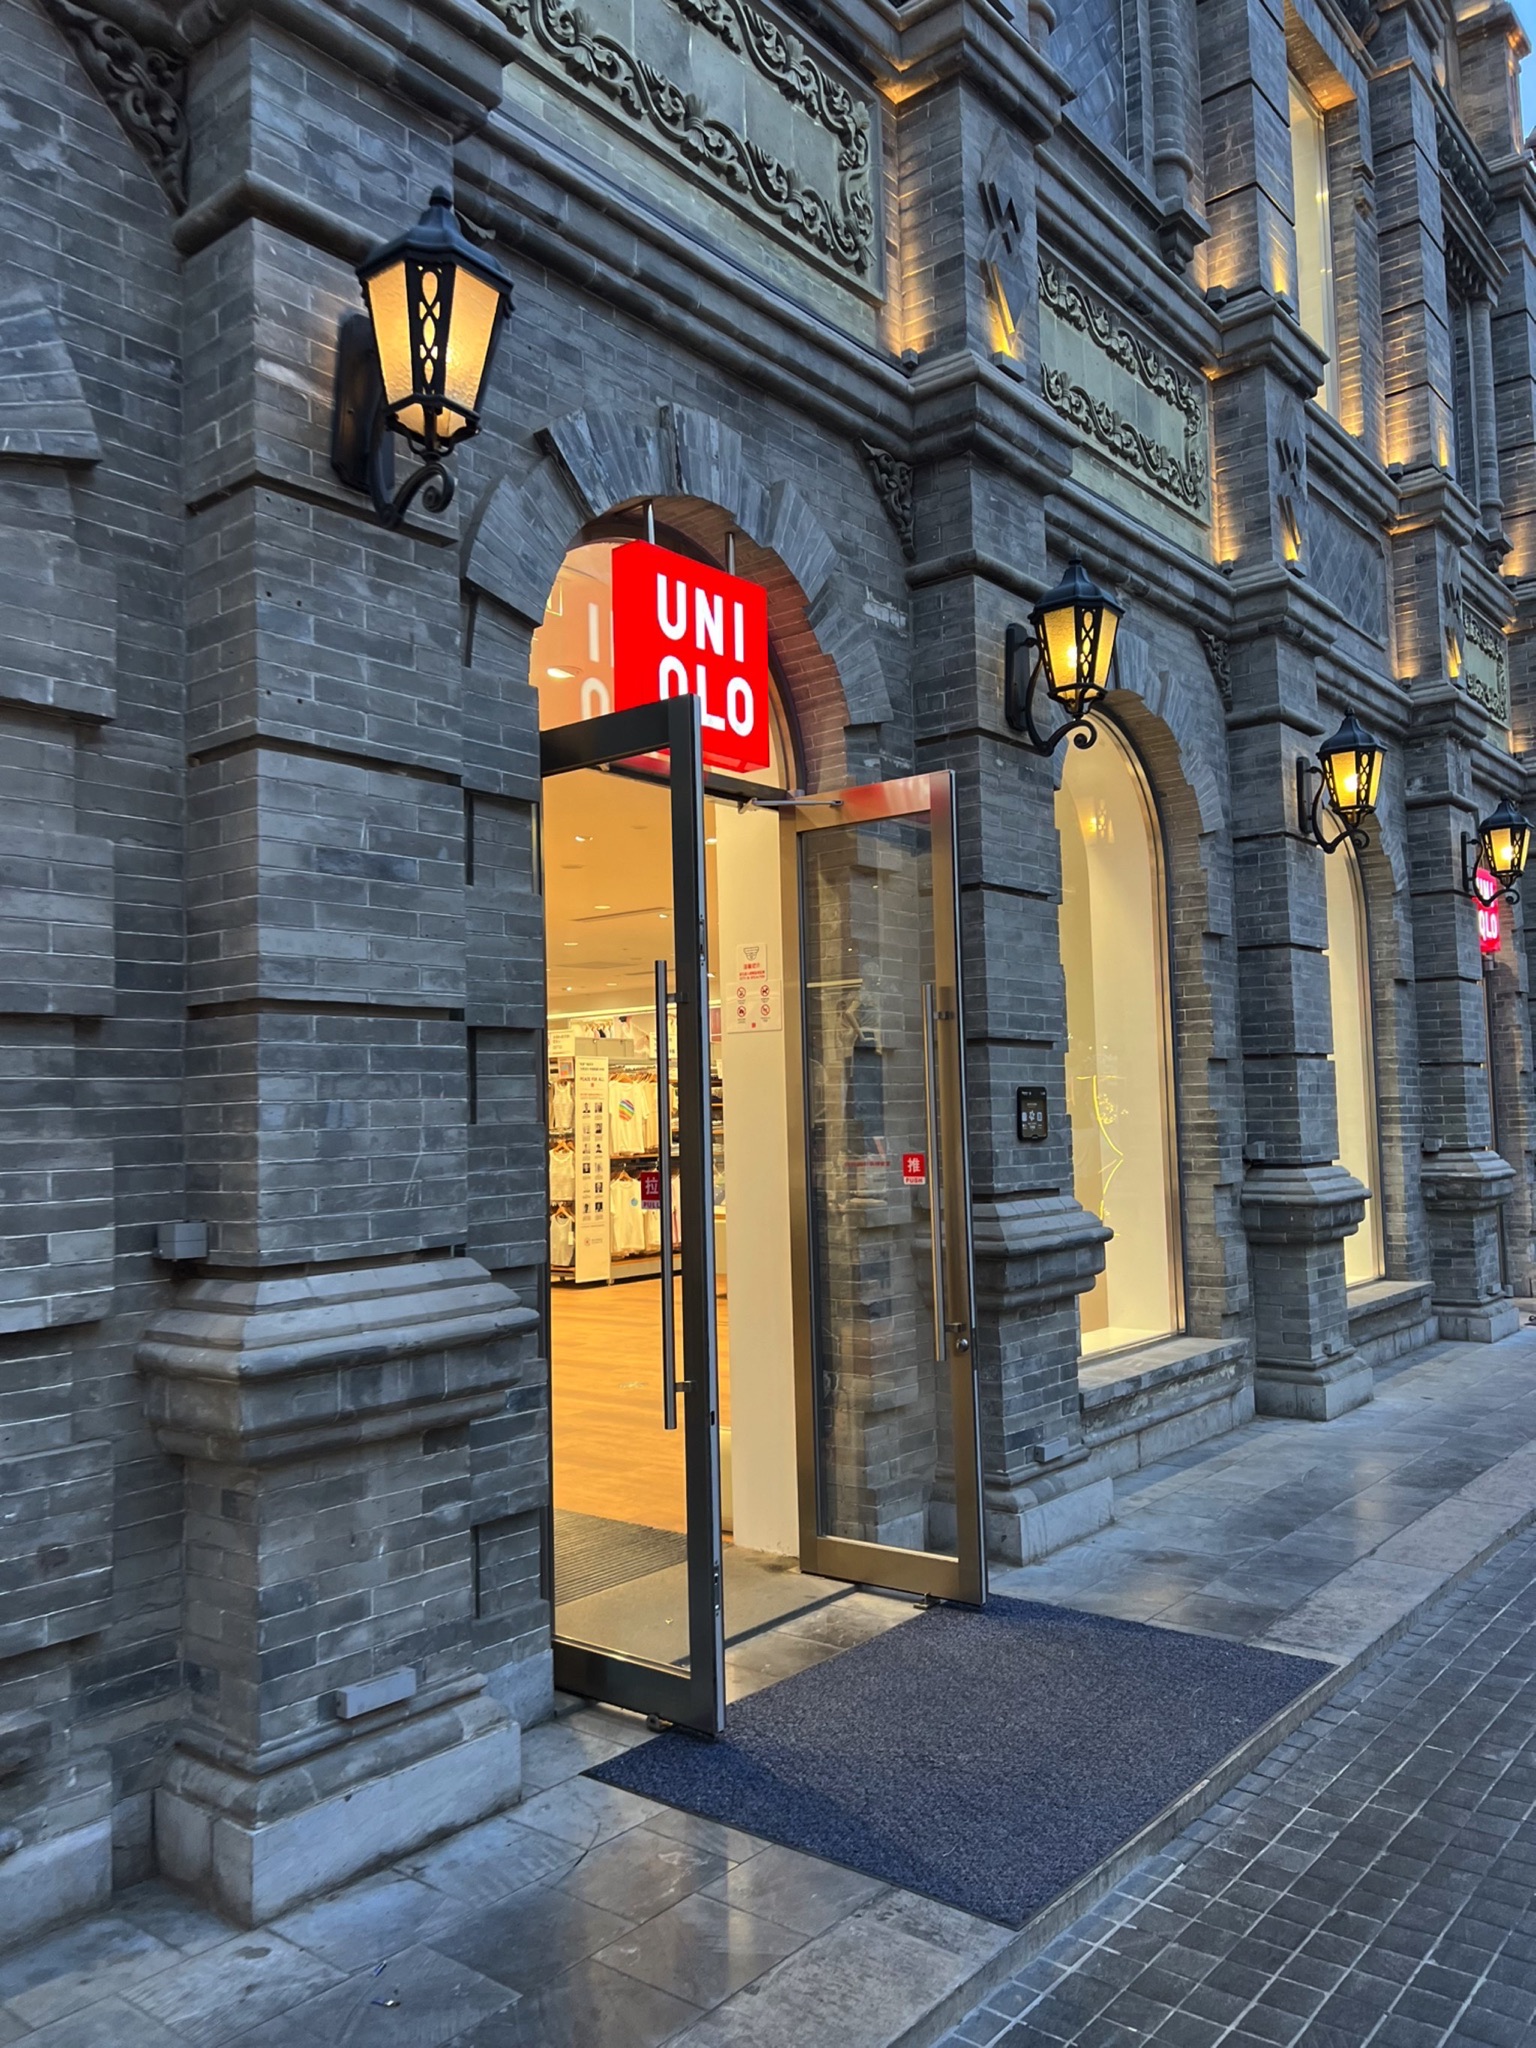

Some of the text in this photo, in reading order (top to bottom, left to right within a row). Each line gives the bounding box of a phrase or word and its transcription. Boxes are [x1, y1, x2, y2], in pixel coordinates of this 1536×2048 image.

[656, 572, 744, 663] UNI
[1478, 909, 1498, 941] QLO
[907, 1157, 921, 1173] 推
[645, 1176, 659, 1195] 拉
